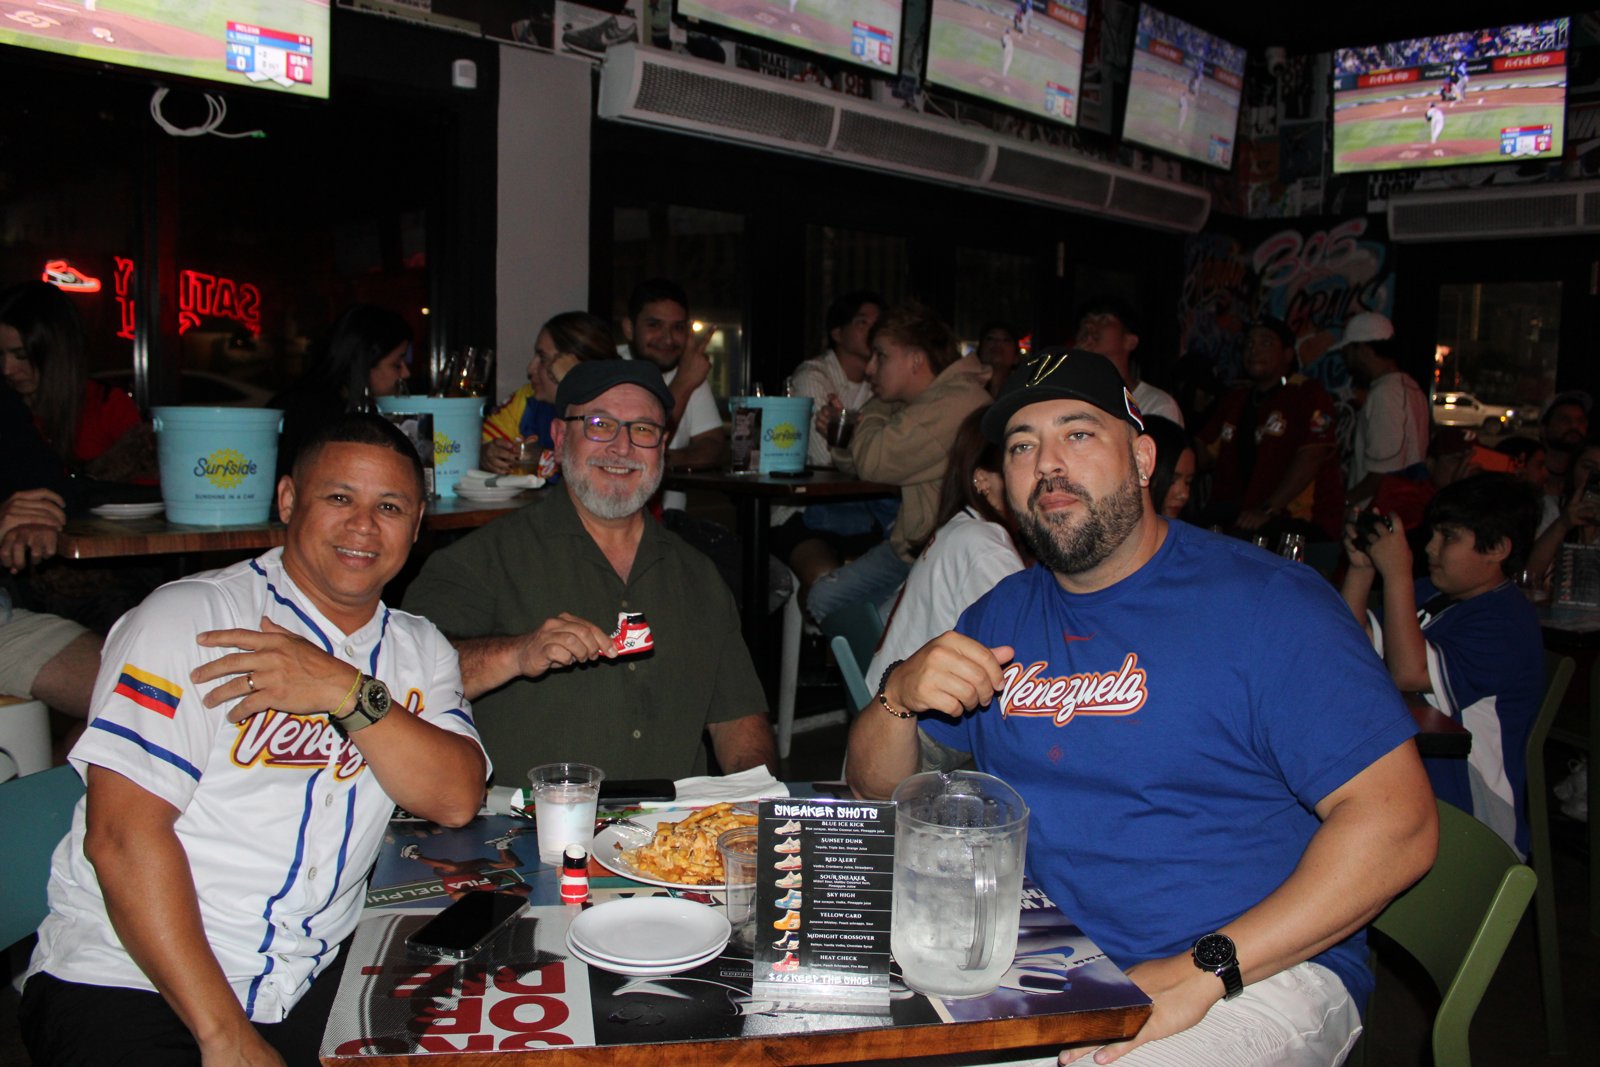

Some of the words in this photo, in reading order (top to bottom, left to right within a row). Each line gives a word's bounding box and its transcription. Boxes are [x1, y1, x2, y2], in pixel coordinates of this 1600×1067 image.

[231, 43, 252, 56] VEN
[236, 56, 246, 70] 0
[289, 54, 308, 66] USA
[294, 66, 304, 81] 0
[193, 458, 258, 477] Surfside
[999, 652, 1148, 728] Venezuela
[774, 804, 834, 818] SNEAKER
[837, 806, 878, 820] SHOTS
[448, 877, 492, 890] FILA
[792, 974, 818, 984] KEEP
[820, 974, 843, 984] THE
